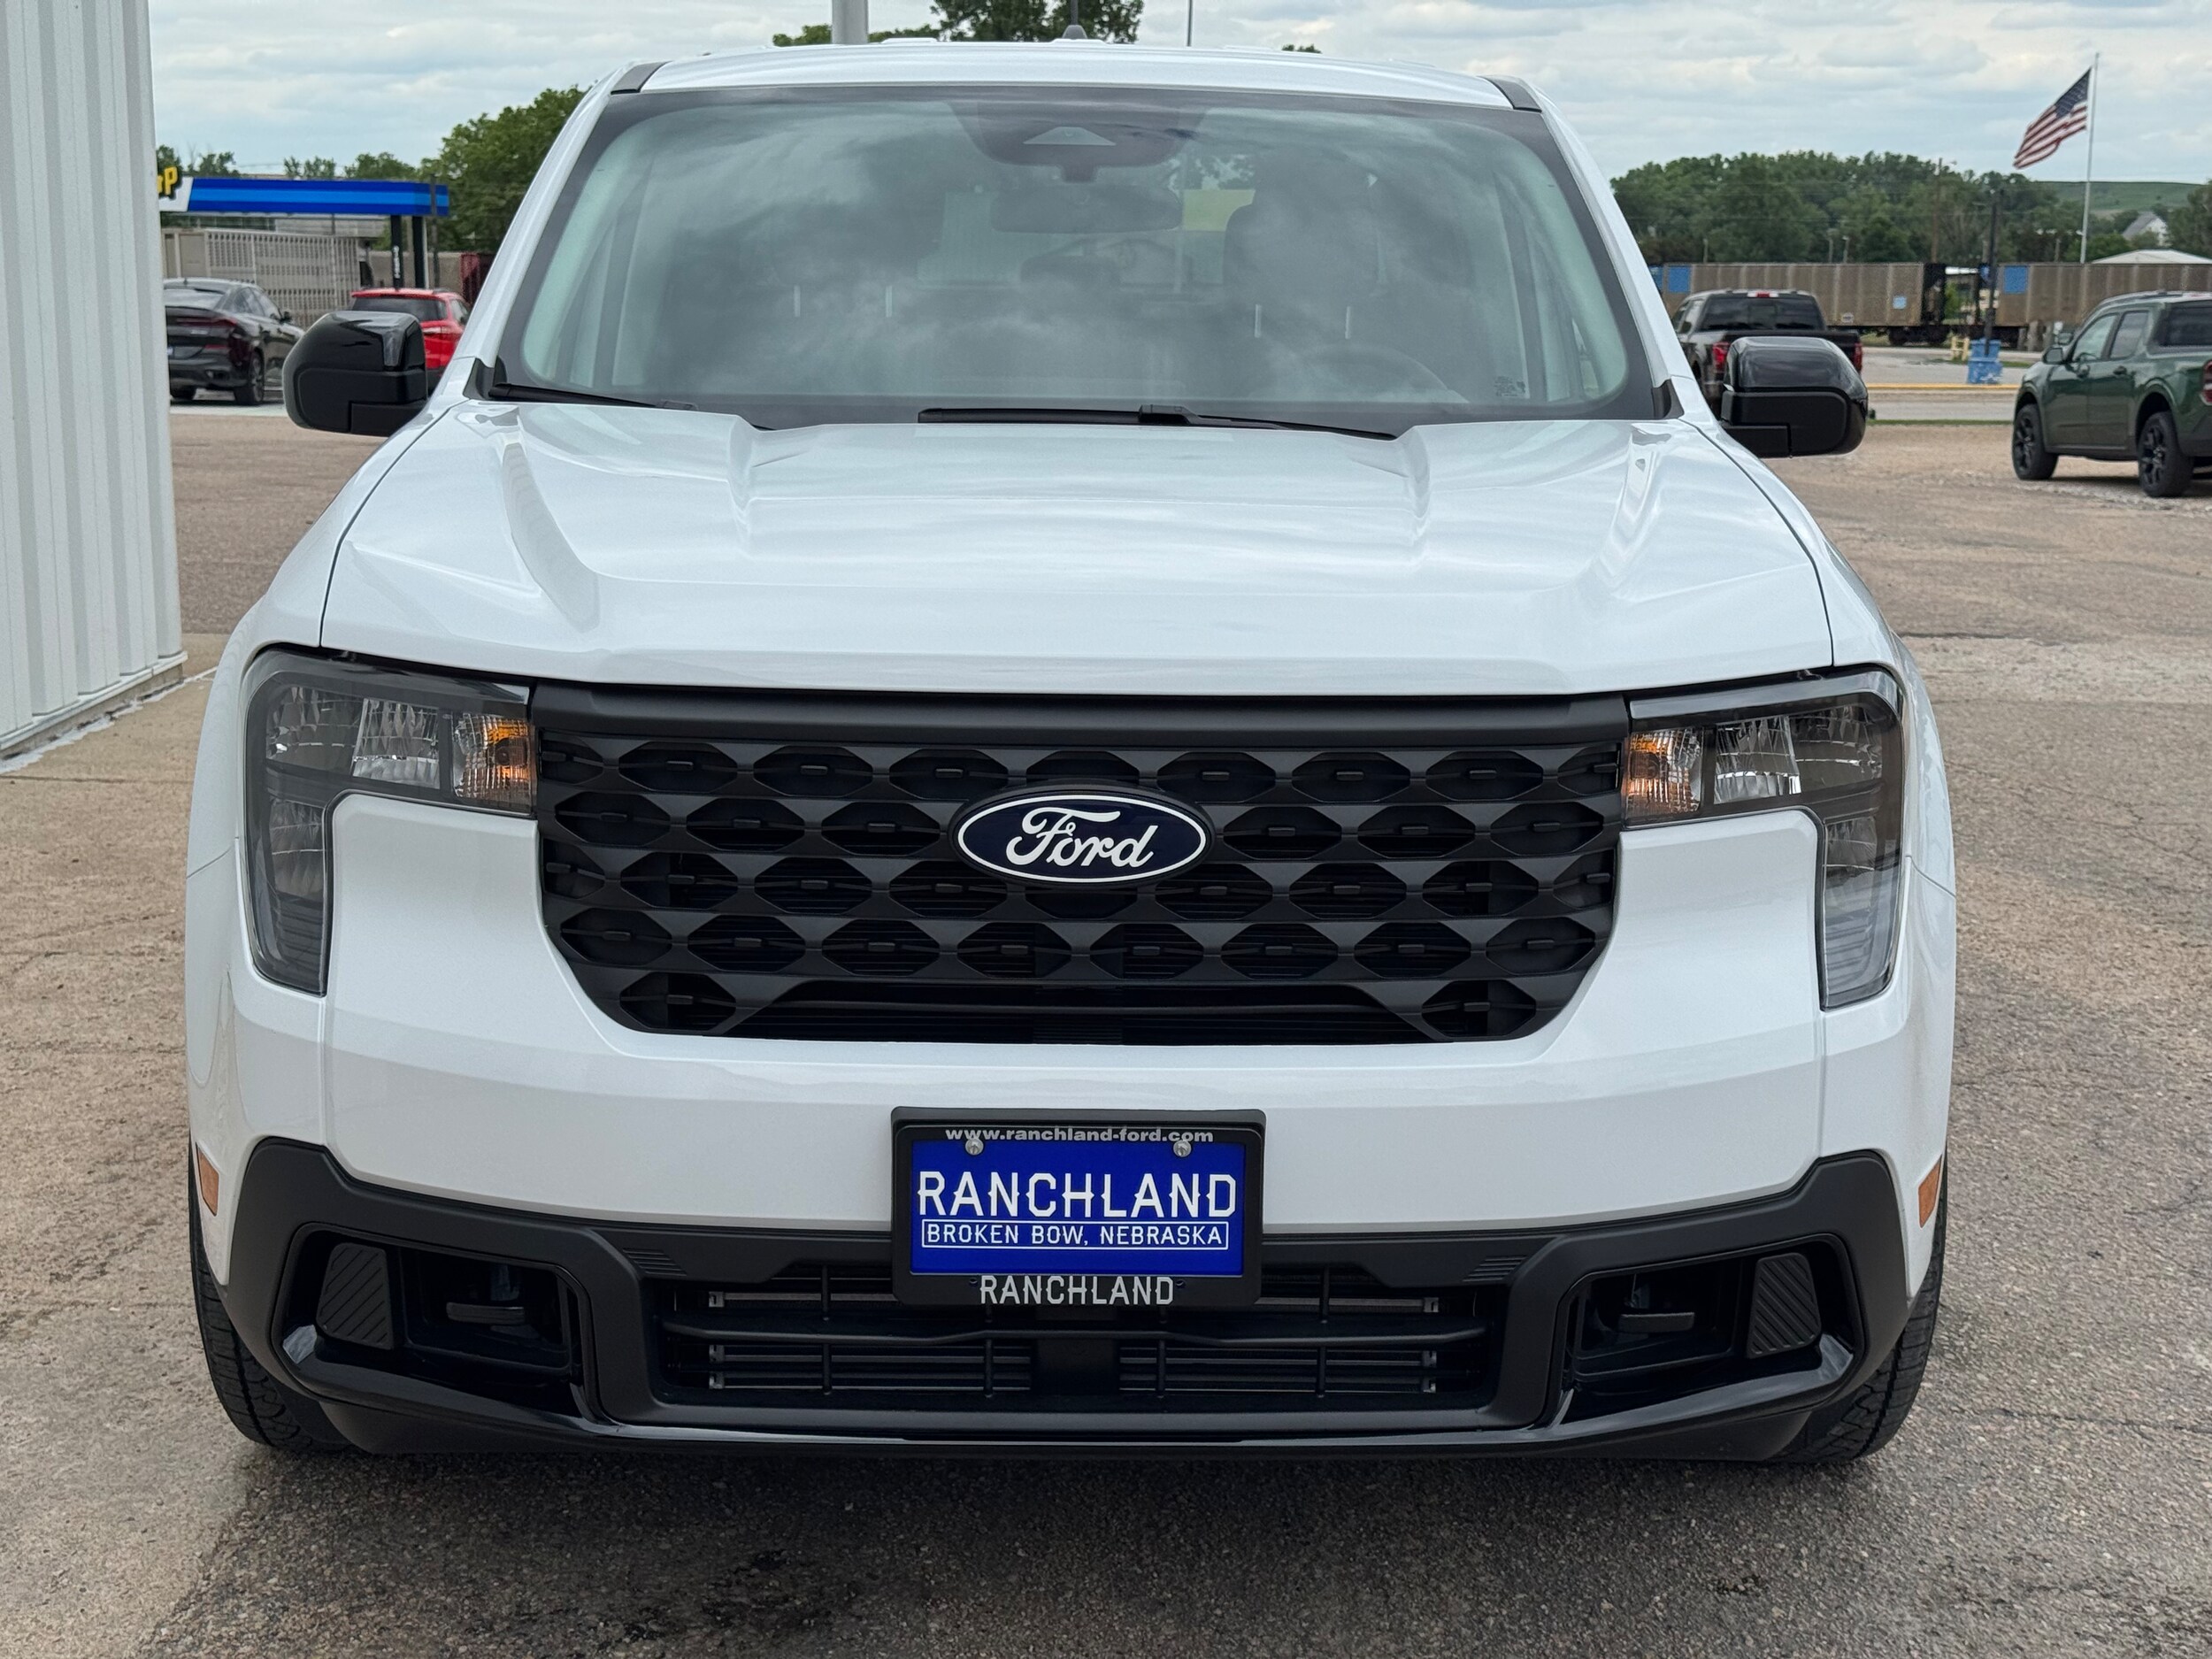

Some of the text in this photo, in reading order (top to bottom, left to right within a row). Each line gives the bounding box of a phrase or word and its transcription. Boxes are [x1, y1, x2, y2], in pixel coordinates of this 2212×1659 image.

[1005, 806, 1159, 868] Ford
[945, 1126, 1214, 1143] www.ranchland-ford.com
[917, 1171, 1237, 1218] RANCHLAND
[926, 1224, 1223, 1246] BROKEN BOW, NEBRASKA
[979, 1275, 1174, 1306] RANCHLAND
